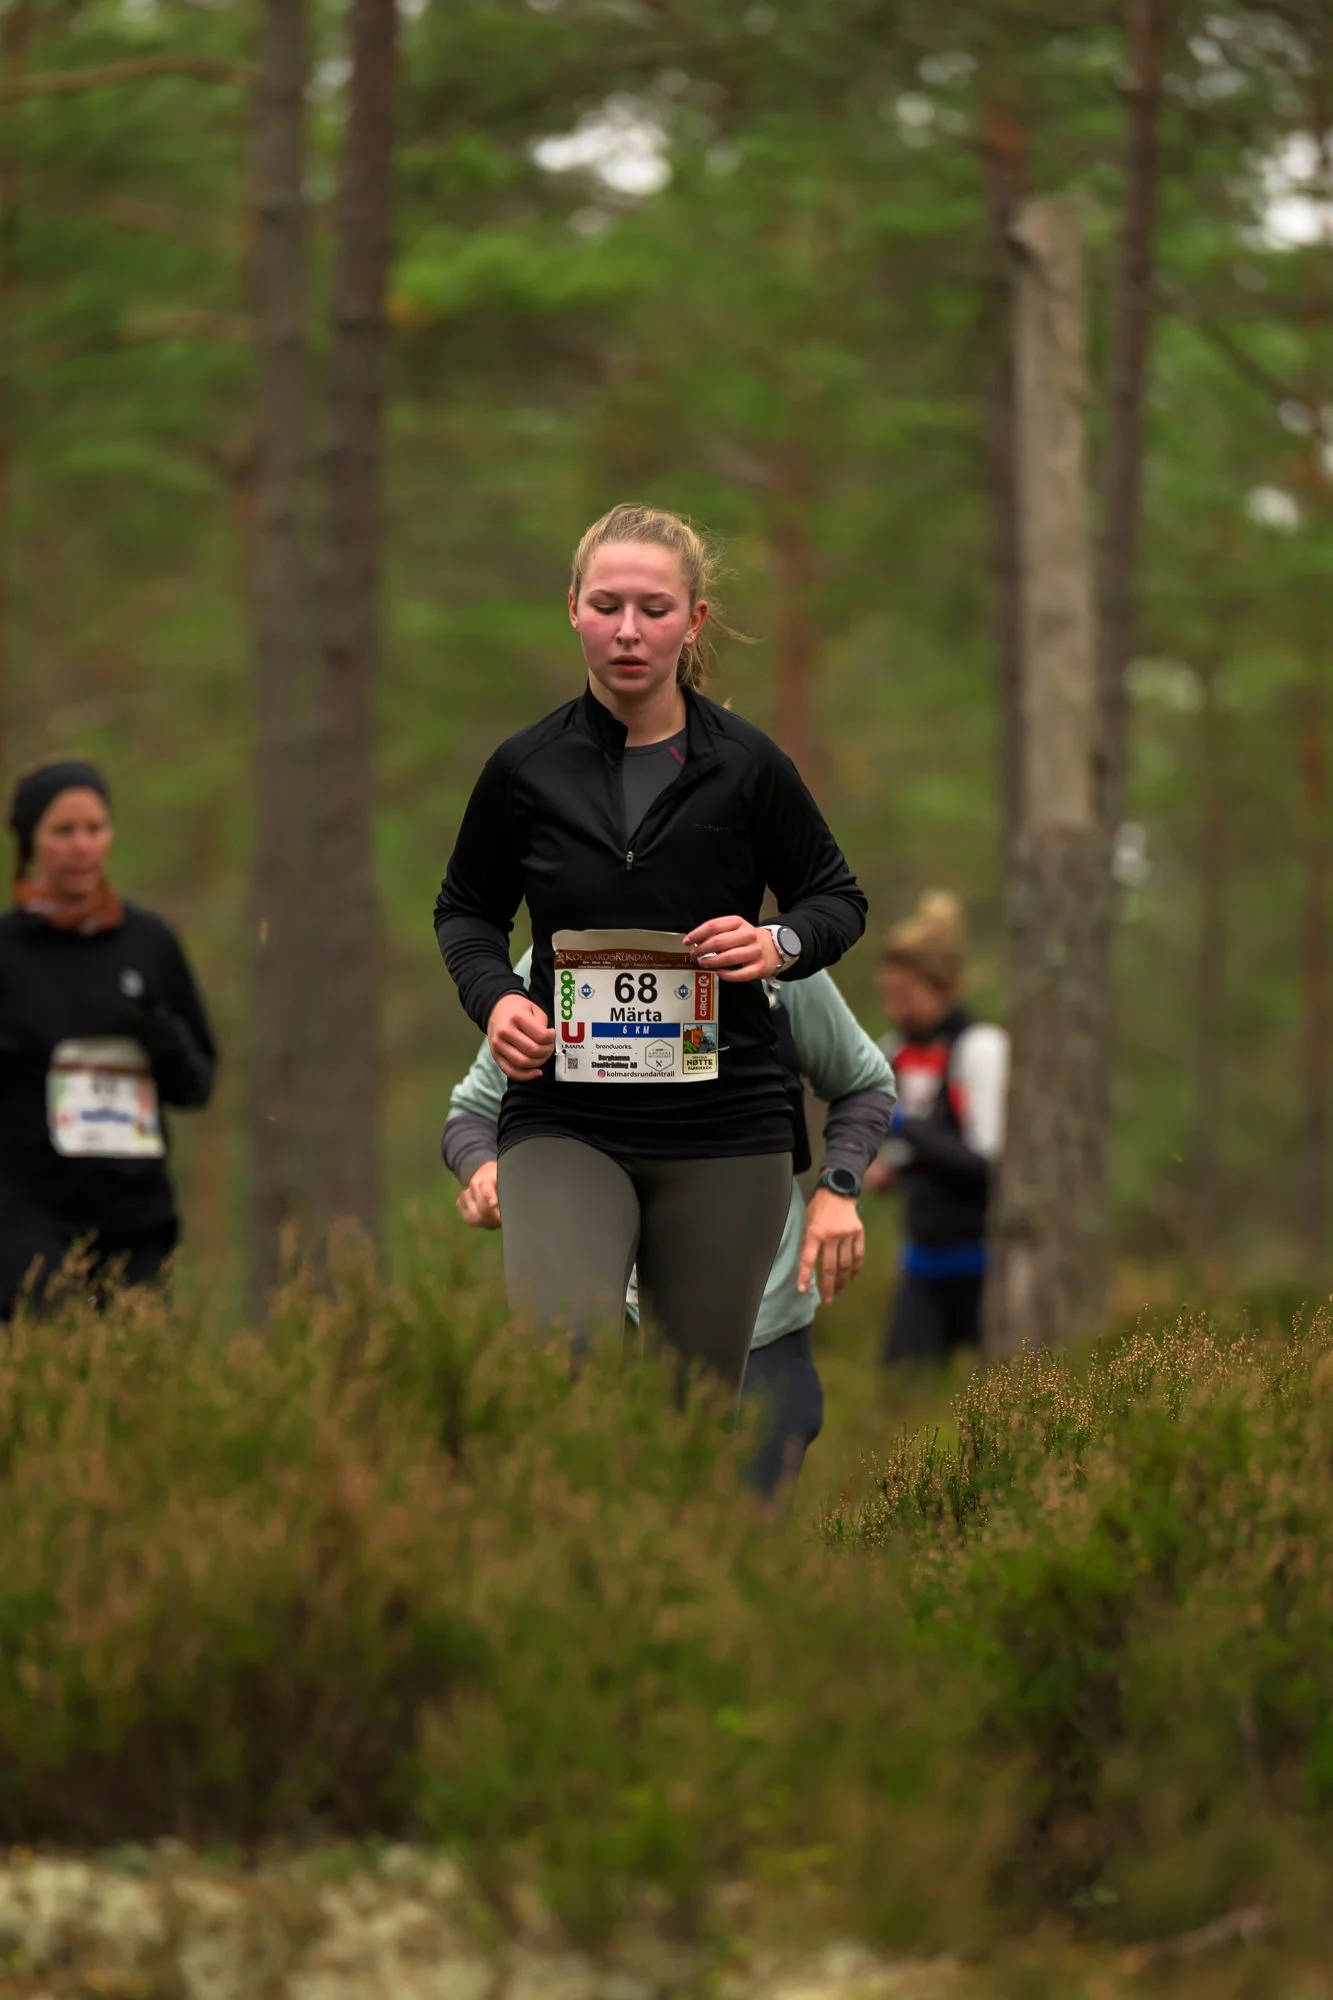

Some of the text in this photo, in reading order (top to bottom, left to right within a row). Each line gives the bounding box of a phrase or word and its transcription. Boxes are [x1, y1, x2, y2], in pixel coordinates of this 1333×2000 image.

[560, 970, 576, 1020] coop
[614, 972, 658, 1004] 68
[700, 988, 708, 1017] CIRCLE
[610, 1007, 662, 1022] Märta
[622, 1025, 650, 1035] 6 KM
